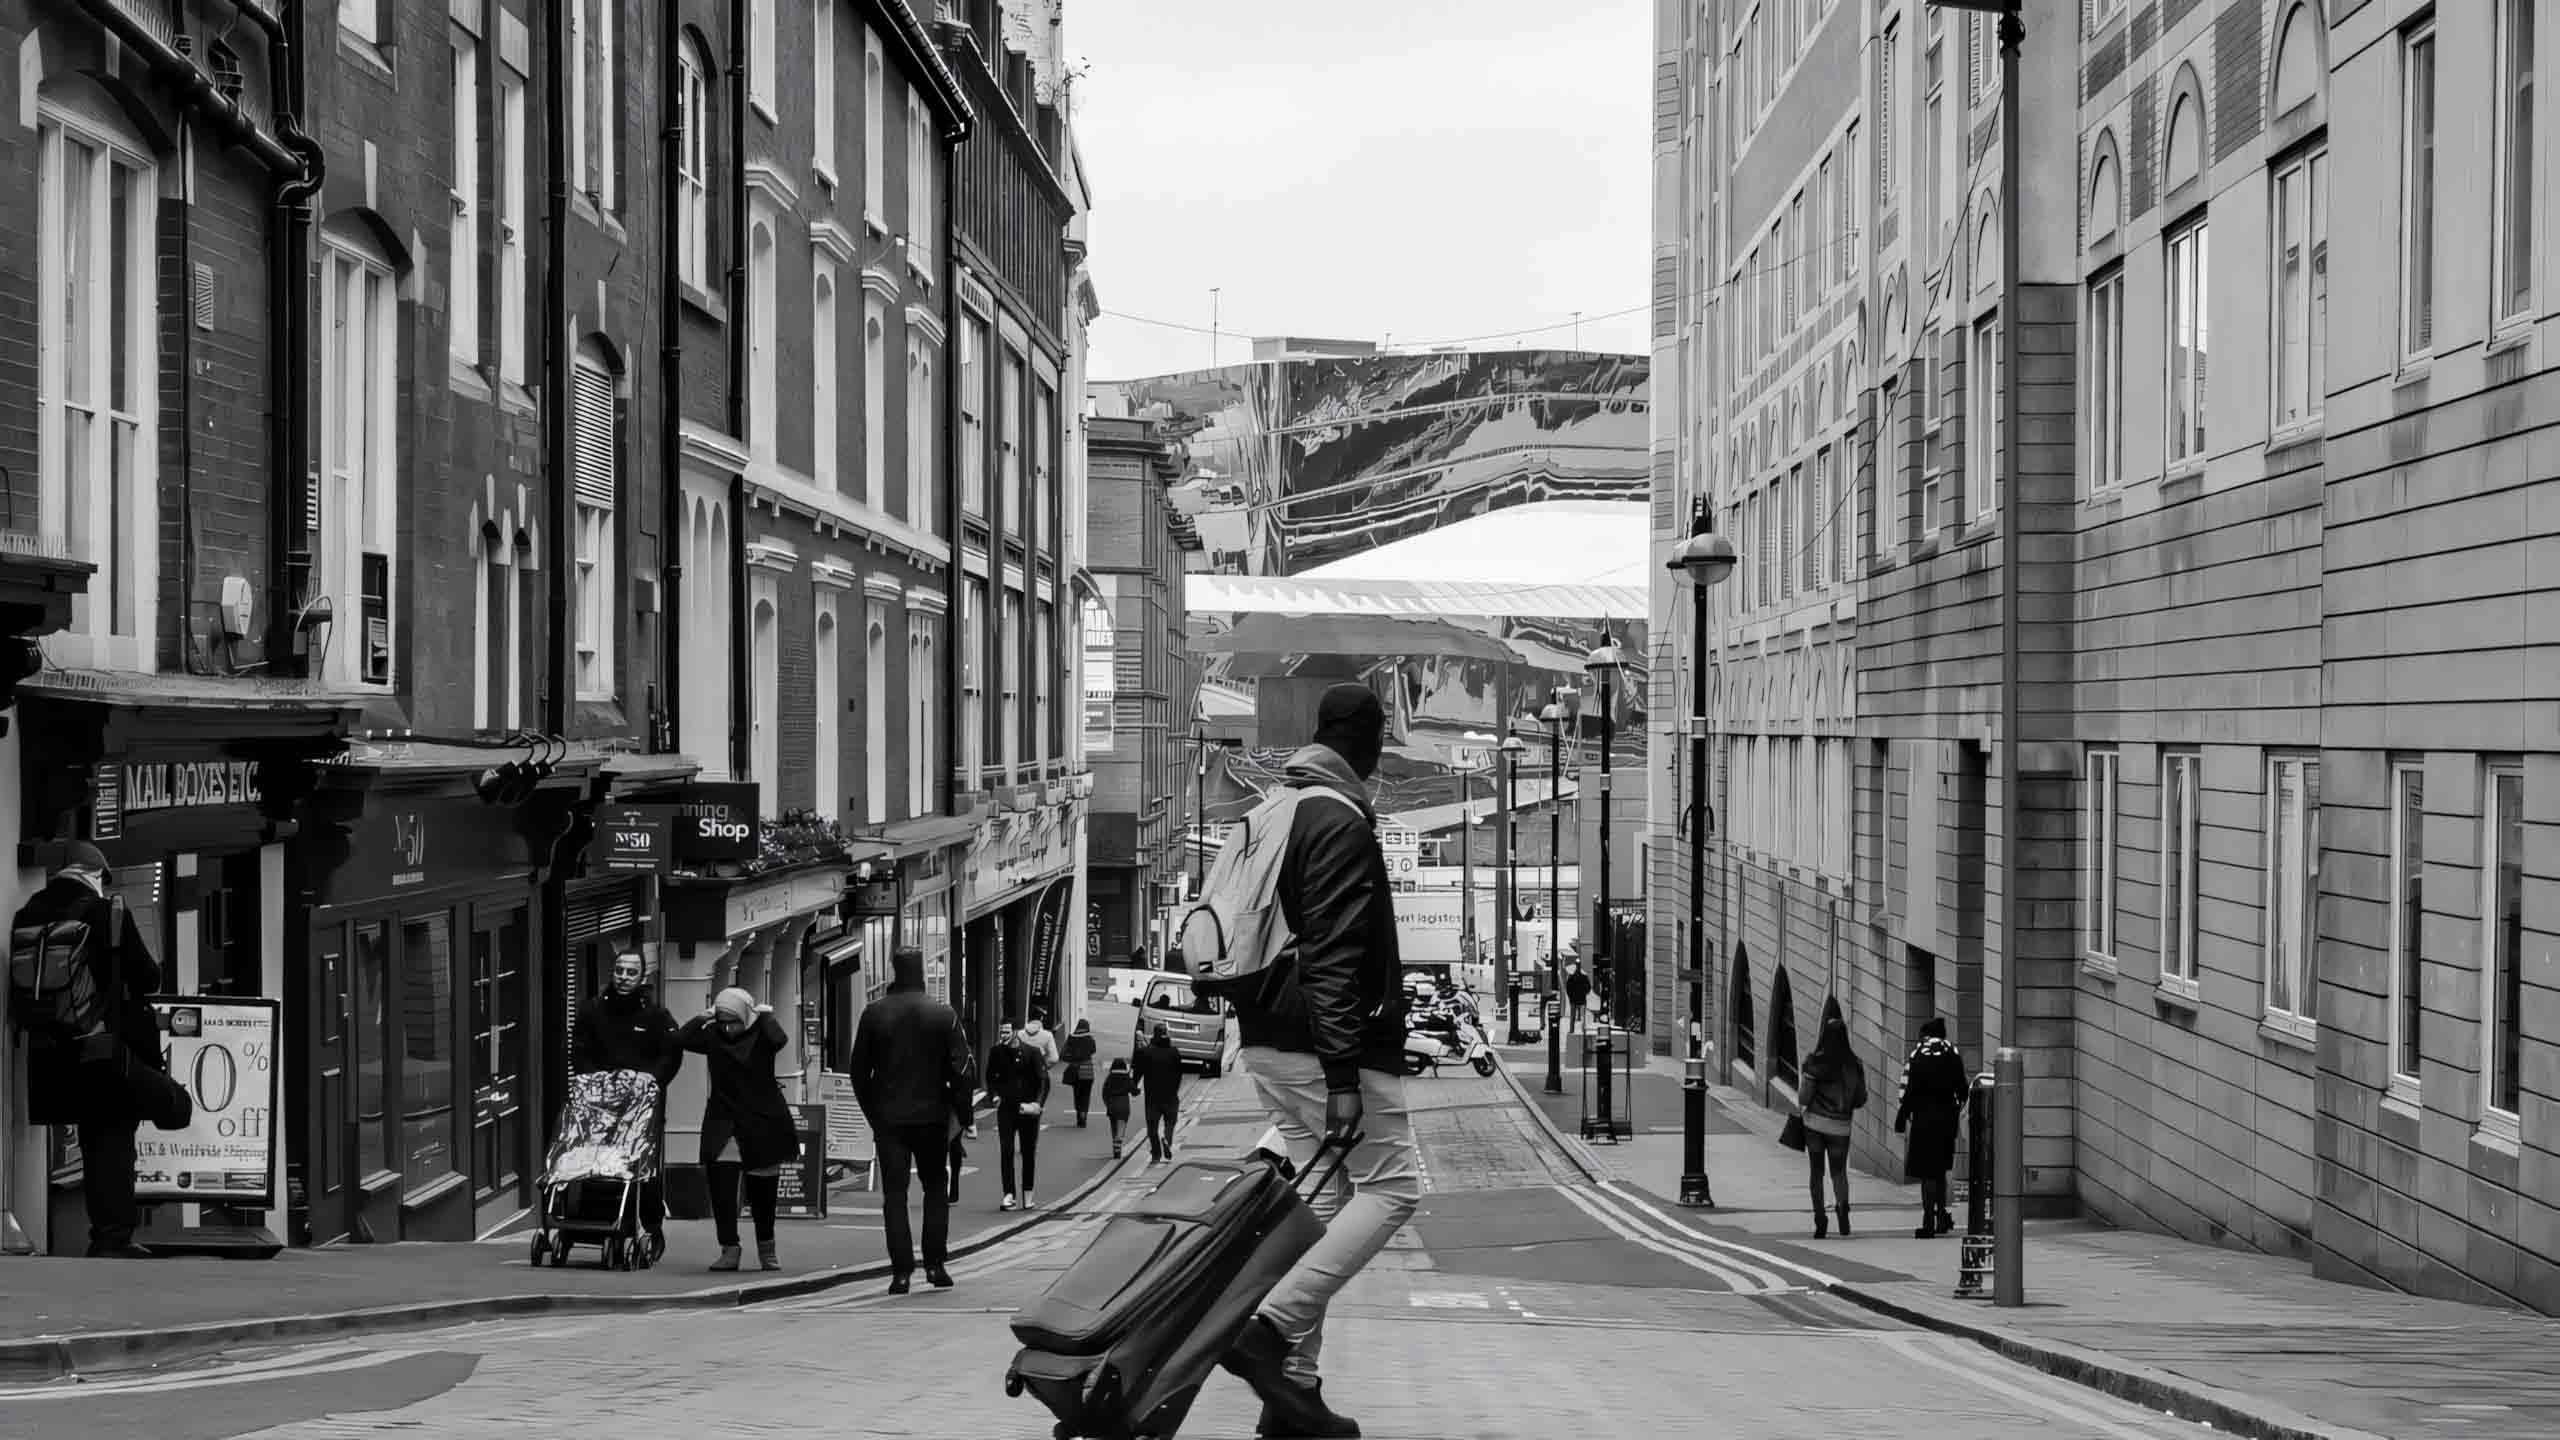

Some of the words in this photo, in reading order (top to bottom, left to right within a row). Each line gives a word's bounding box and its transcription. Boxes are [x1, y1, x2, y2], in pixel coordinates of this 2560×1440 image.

[124, 764, 171, 810] MAIL
[174, 762, 226, 806] BOXES
[228, 761, 261, 802] ETC.
[699, 817, 750, 843] Shop
[217, 1107, 269, 1137] off
